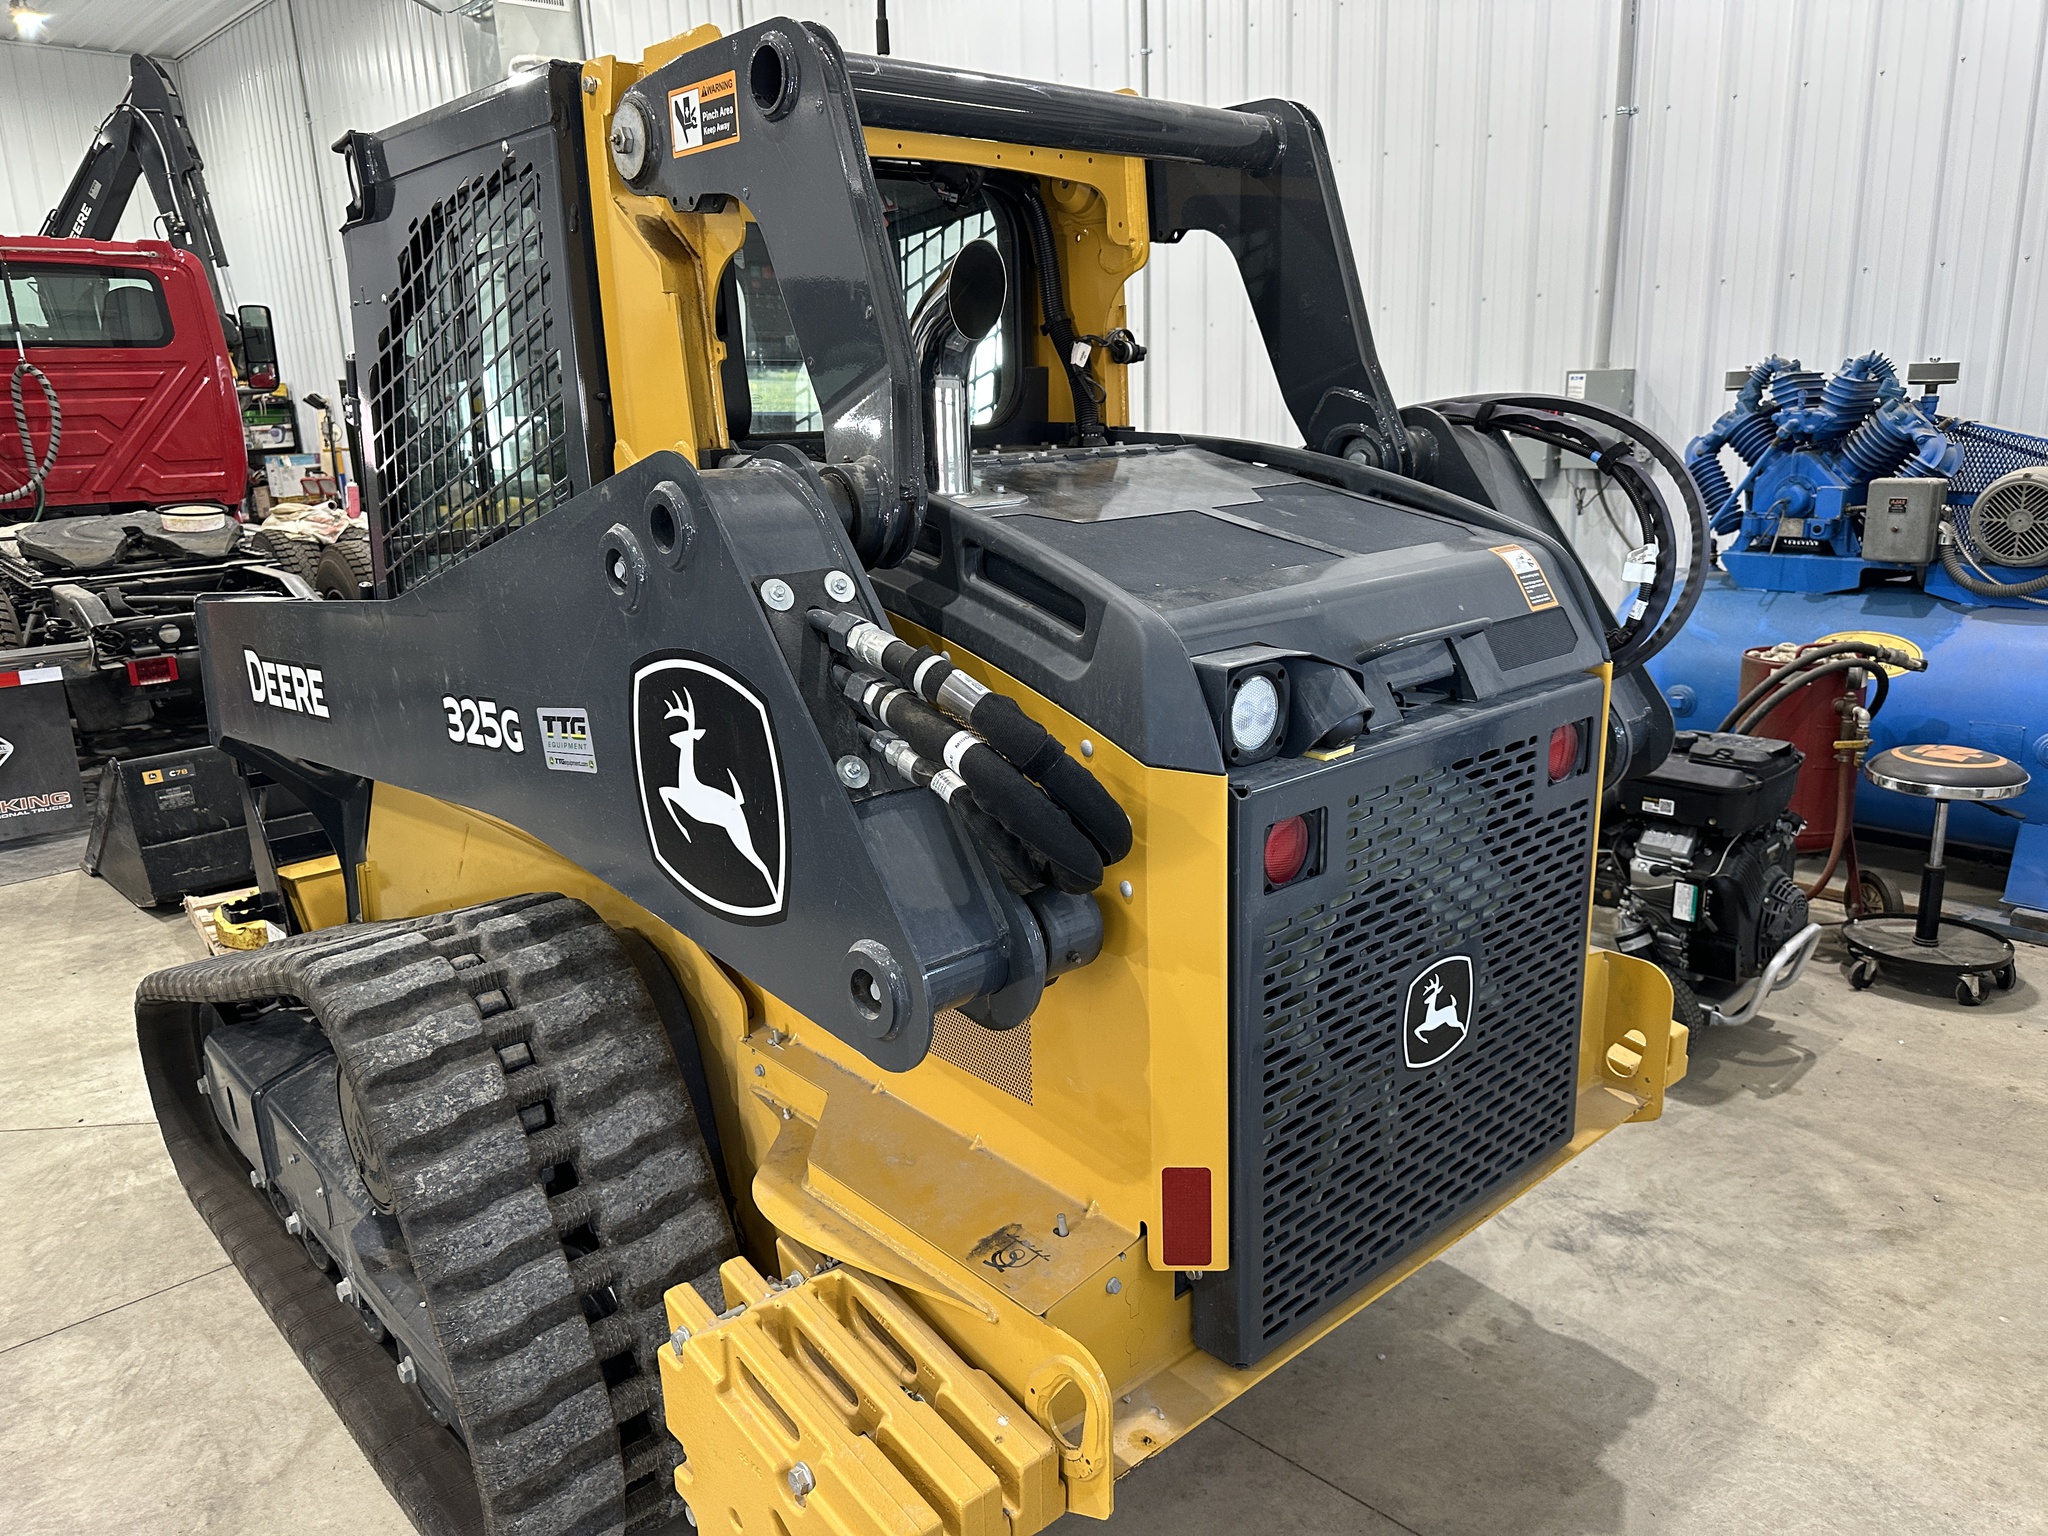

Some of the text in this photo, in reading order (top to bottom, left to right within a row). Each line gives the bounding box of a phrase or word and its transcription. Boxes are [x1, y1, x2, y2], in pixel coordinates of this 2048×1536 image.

[707, 79, 733, 94] WARNING
[702, 106, 734, 122] Pinch Area
[703, 122, 730, 135] Keep Away
[243, 649, 330, 718] DEERE
[442, 696, 525, 753] 325G
[542, 716, 586, 740] TTG
[548, 741, 587, 750] EQUIPMENT
[0, 791, 71, 813] KING
[0, 804, 73, 819] ONAL TRUCKS
